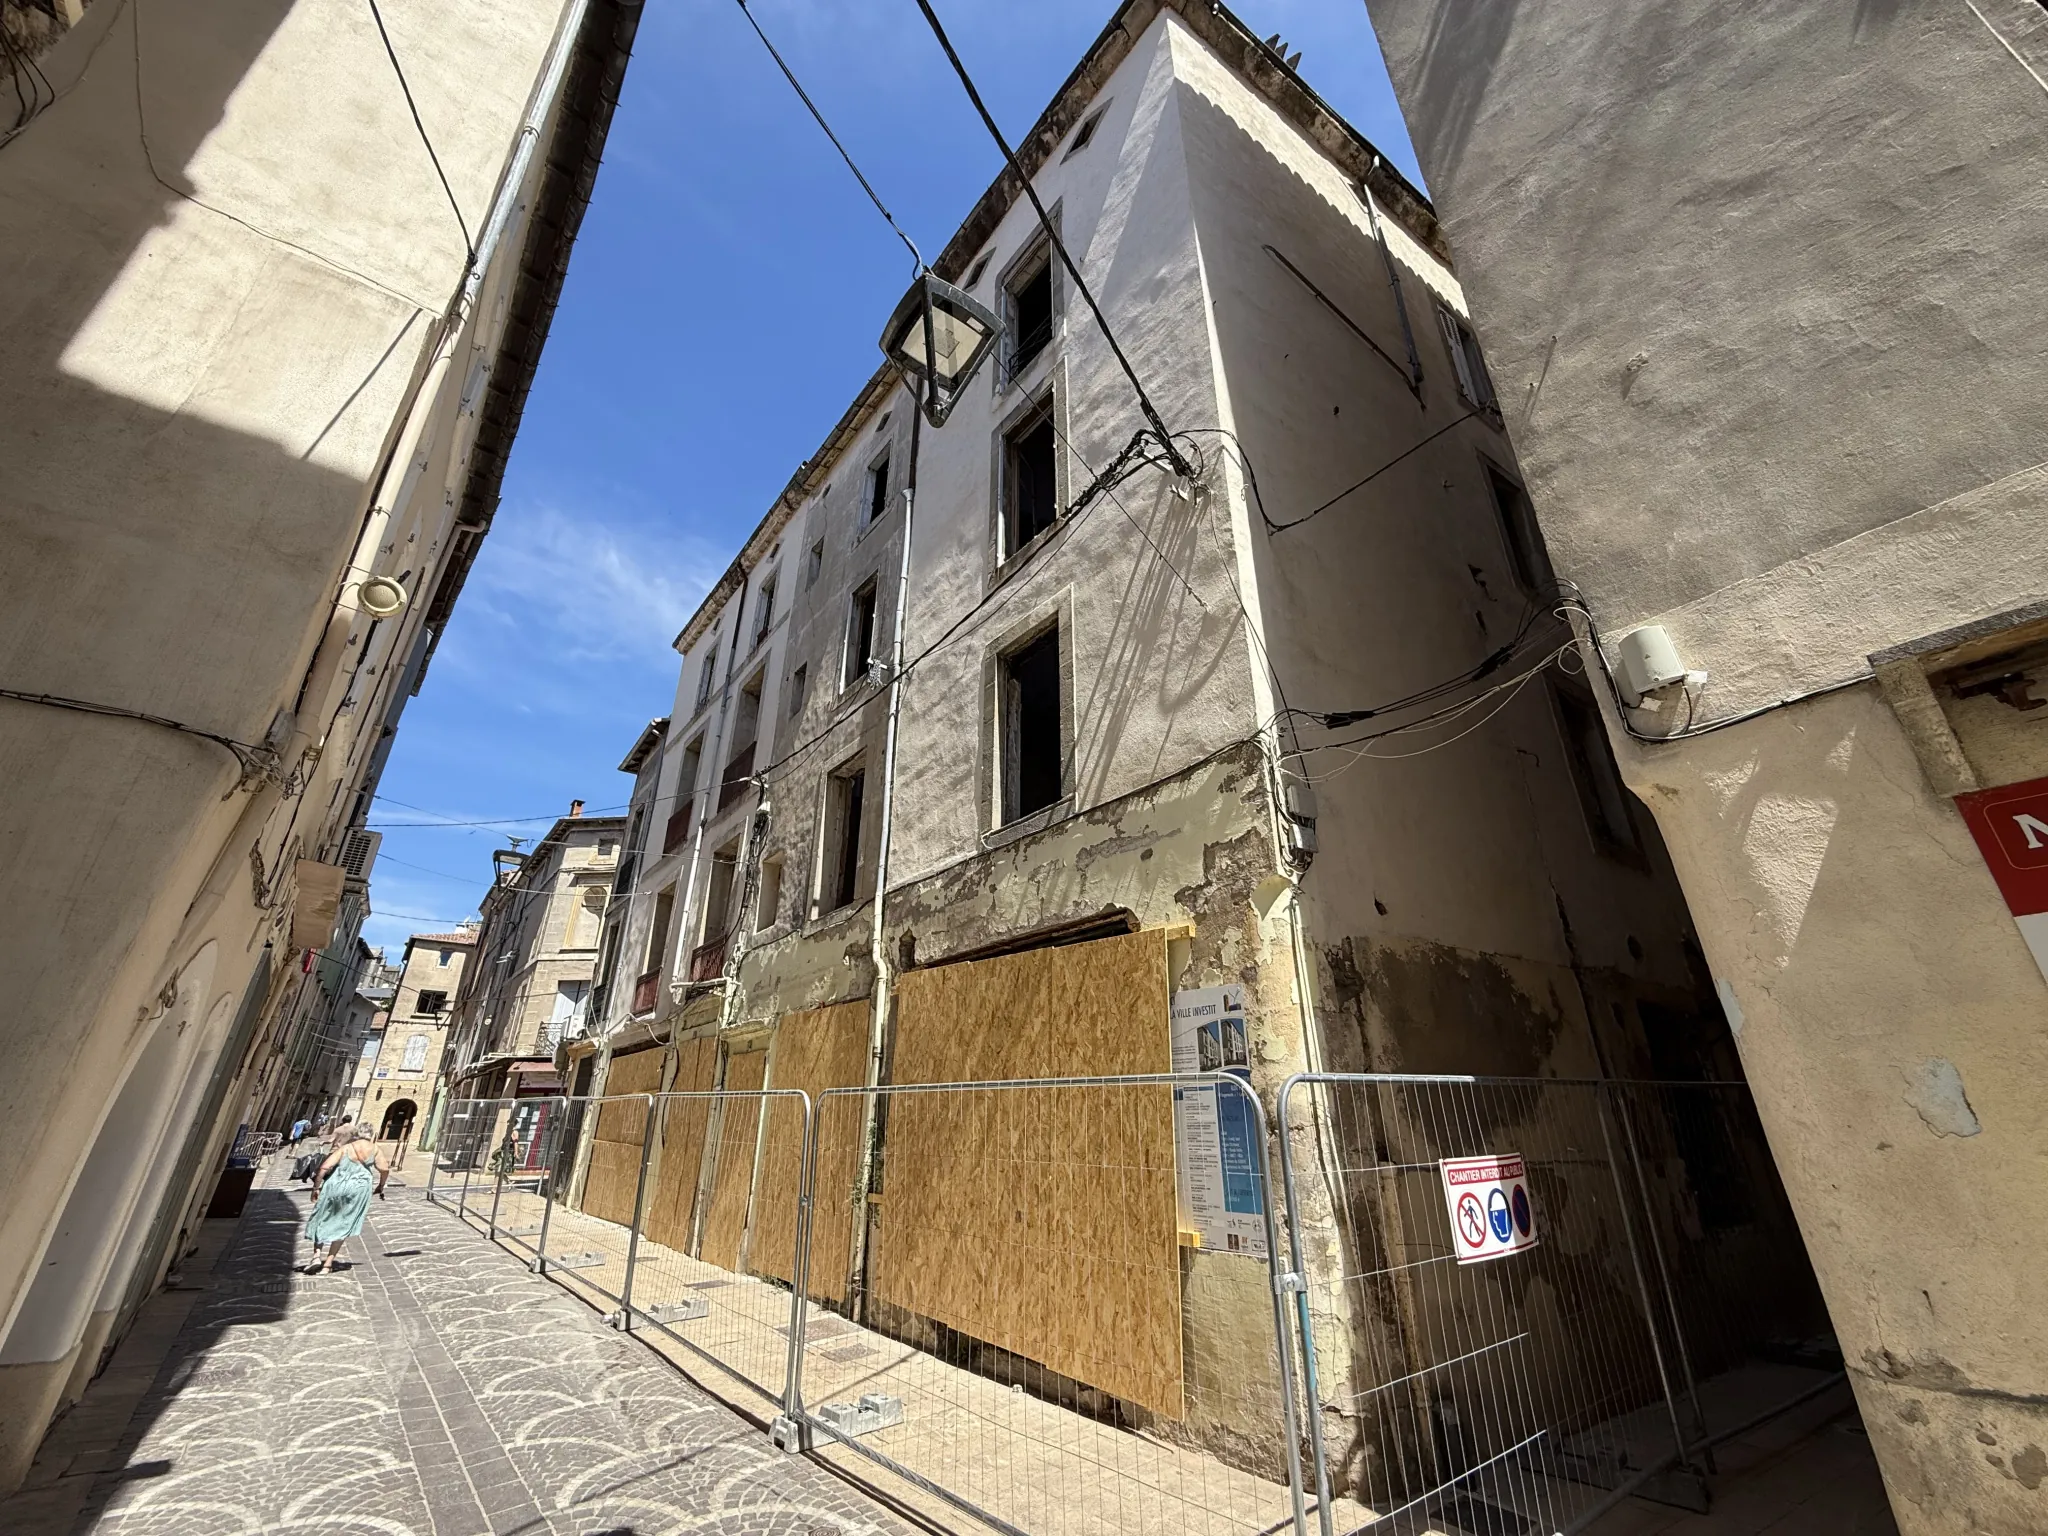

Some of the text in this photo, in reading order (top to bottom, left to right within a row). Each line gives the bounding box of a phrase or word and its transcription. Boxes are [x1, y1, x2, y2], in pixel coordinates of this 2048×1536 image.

[1176, 1007, 1191, 1018] VILLE
[1192, 1004, 1216, 1016] INVESTIT
[1449, 1170, 1480, 1183] CHANTIER
[1481, 1167, 1503, 1180] INTERDIT
